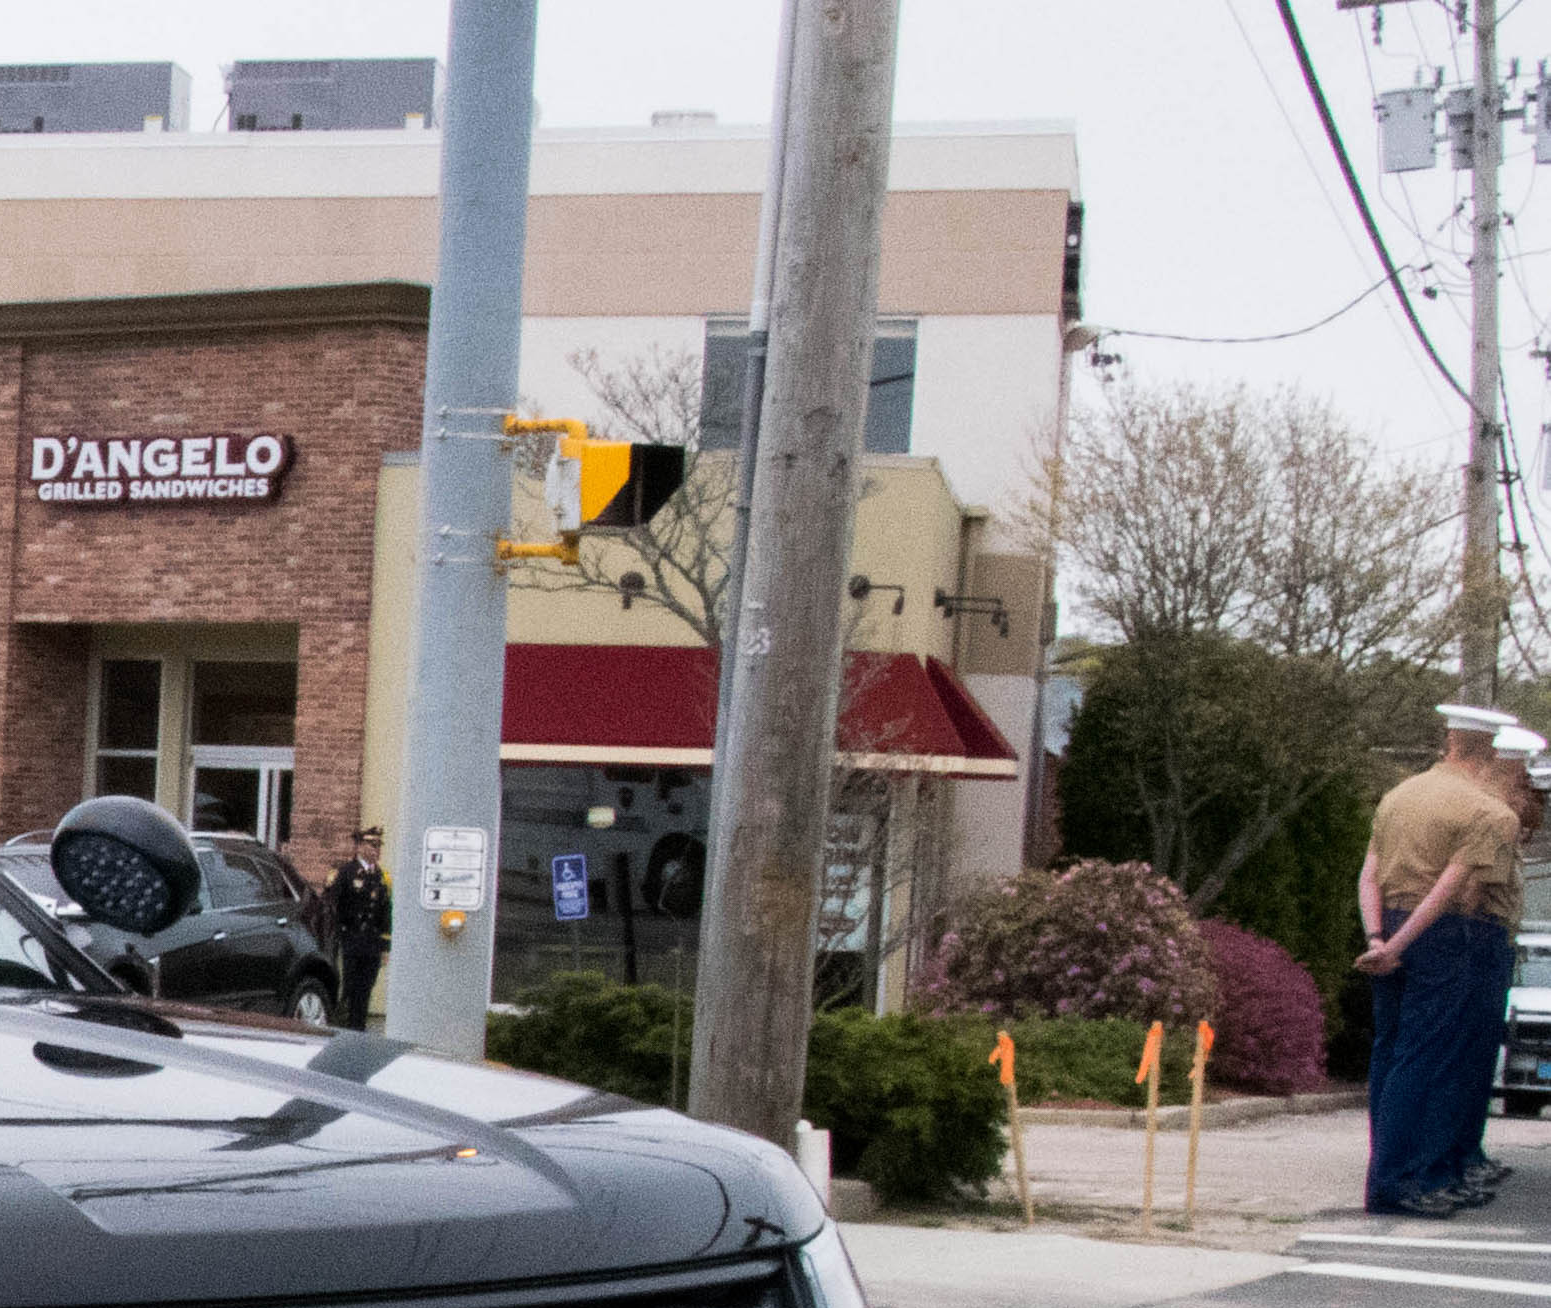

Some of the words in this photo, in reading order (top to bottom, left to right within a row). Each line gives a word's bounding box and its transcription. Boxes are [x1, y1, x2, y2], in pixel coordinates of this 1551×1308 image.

[31, 435, 282, 480] D'ANGELO
[38, 481, 122, 500] GRILLED
[129, 478, 269, 499] SANDWICHES
